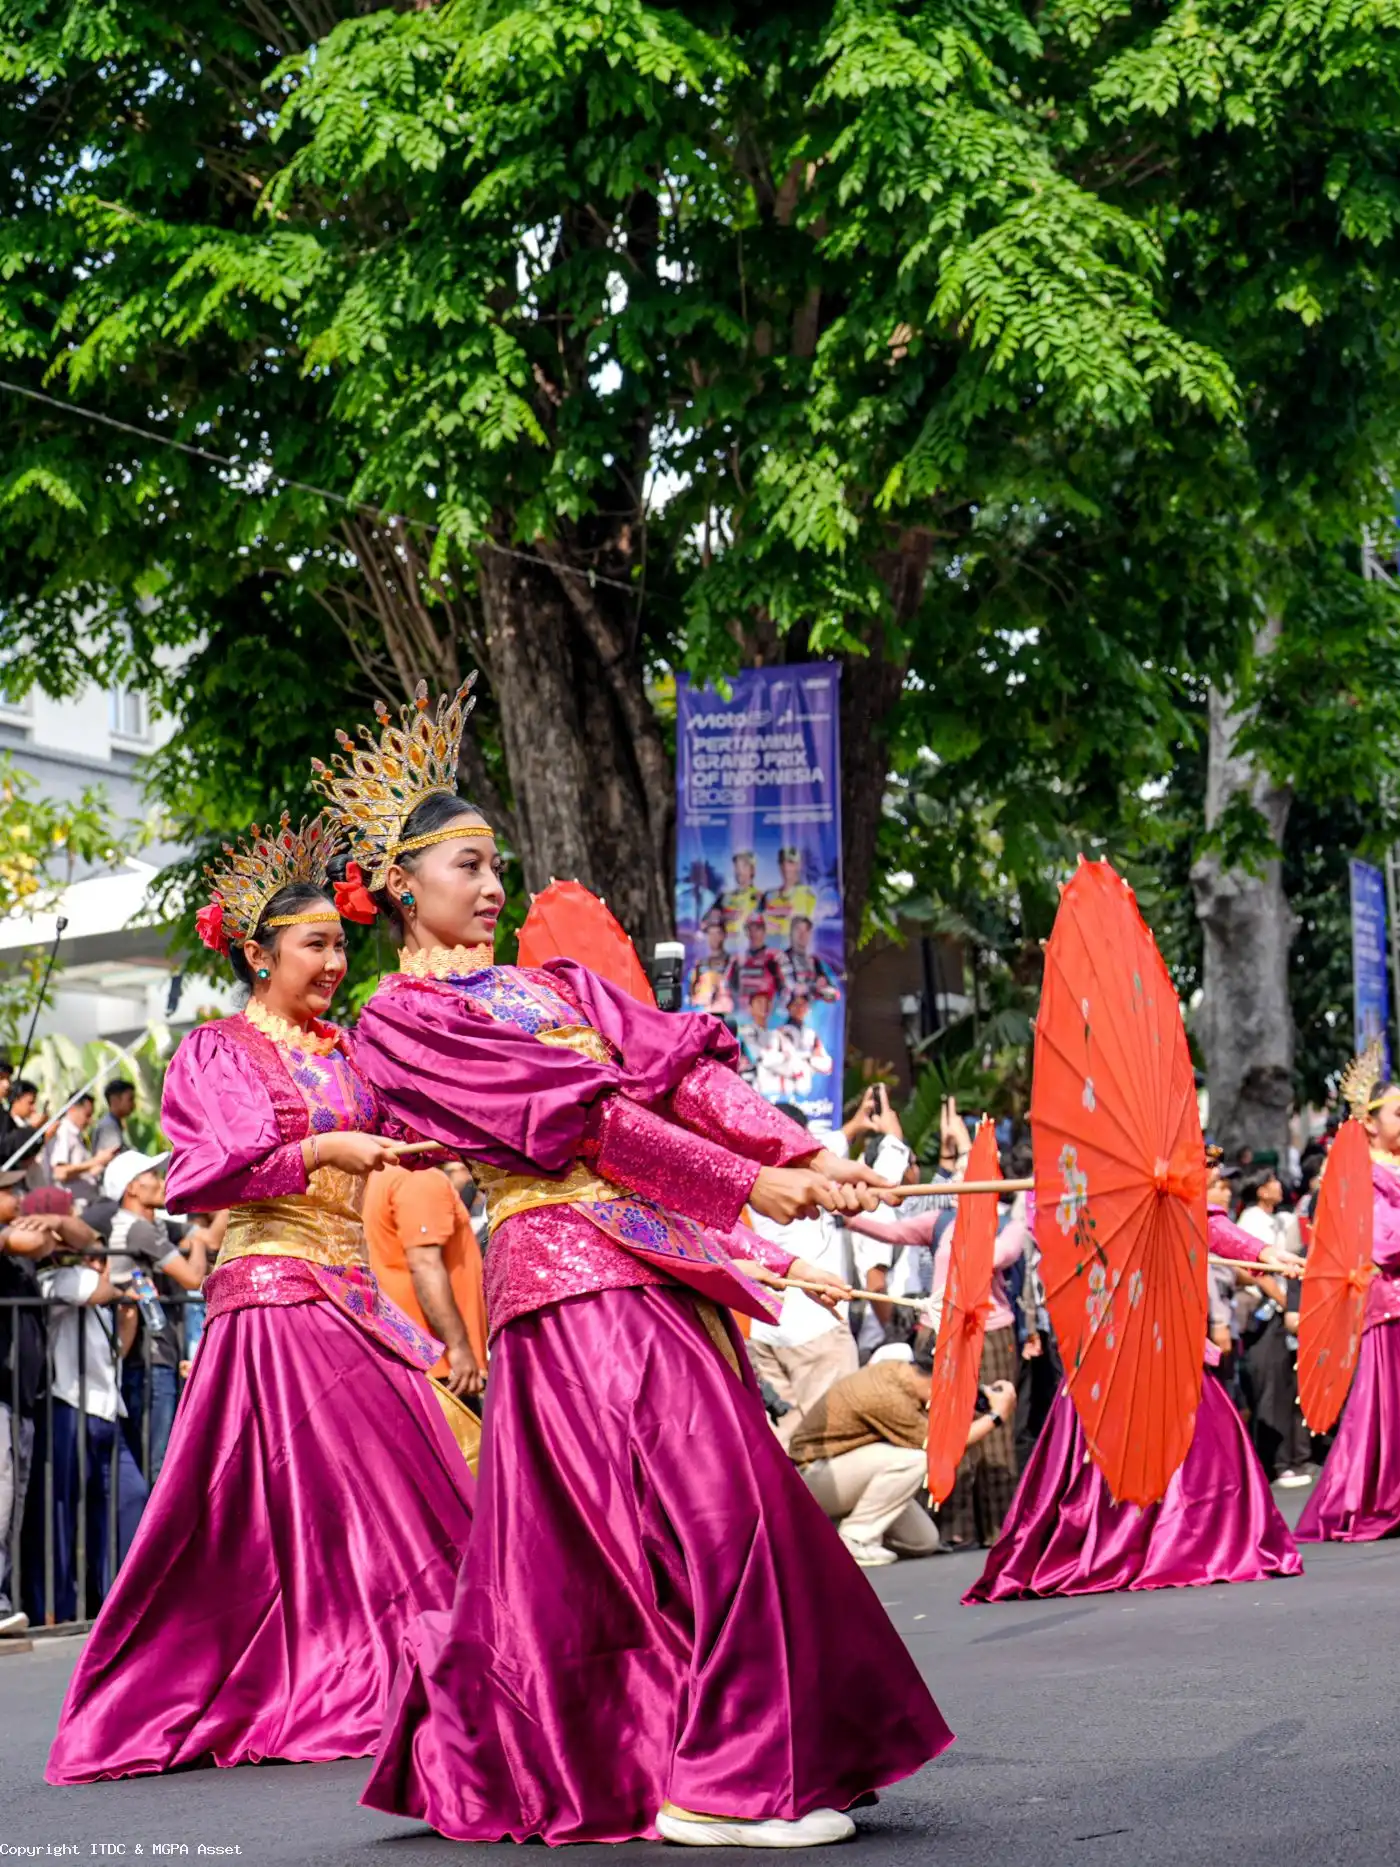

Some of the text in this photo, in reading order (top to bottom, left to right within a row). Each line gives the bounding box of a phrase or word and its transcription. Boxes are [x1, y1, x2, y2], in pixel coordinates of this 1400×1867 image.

[693, 732, 804, 753] PERTAMINA
[693, 750, 807, 770] GRAND PRIX
[692, 766, 825, 787] OF INDONESIA
